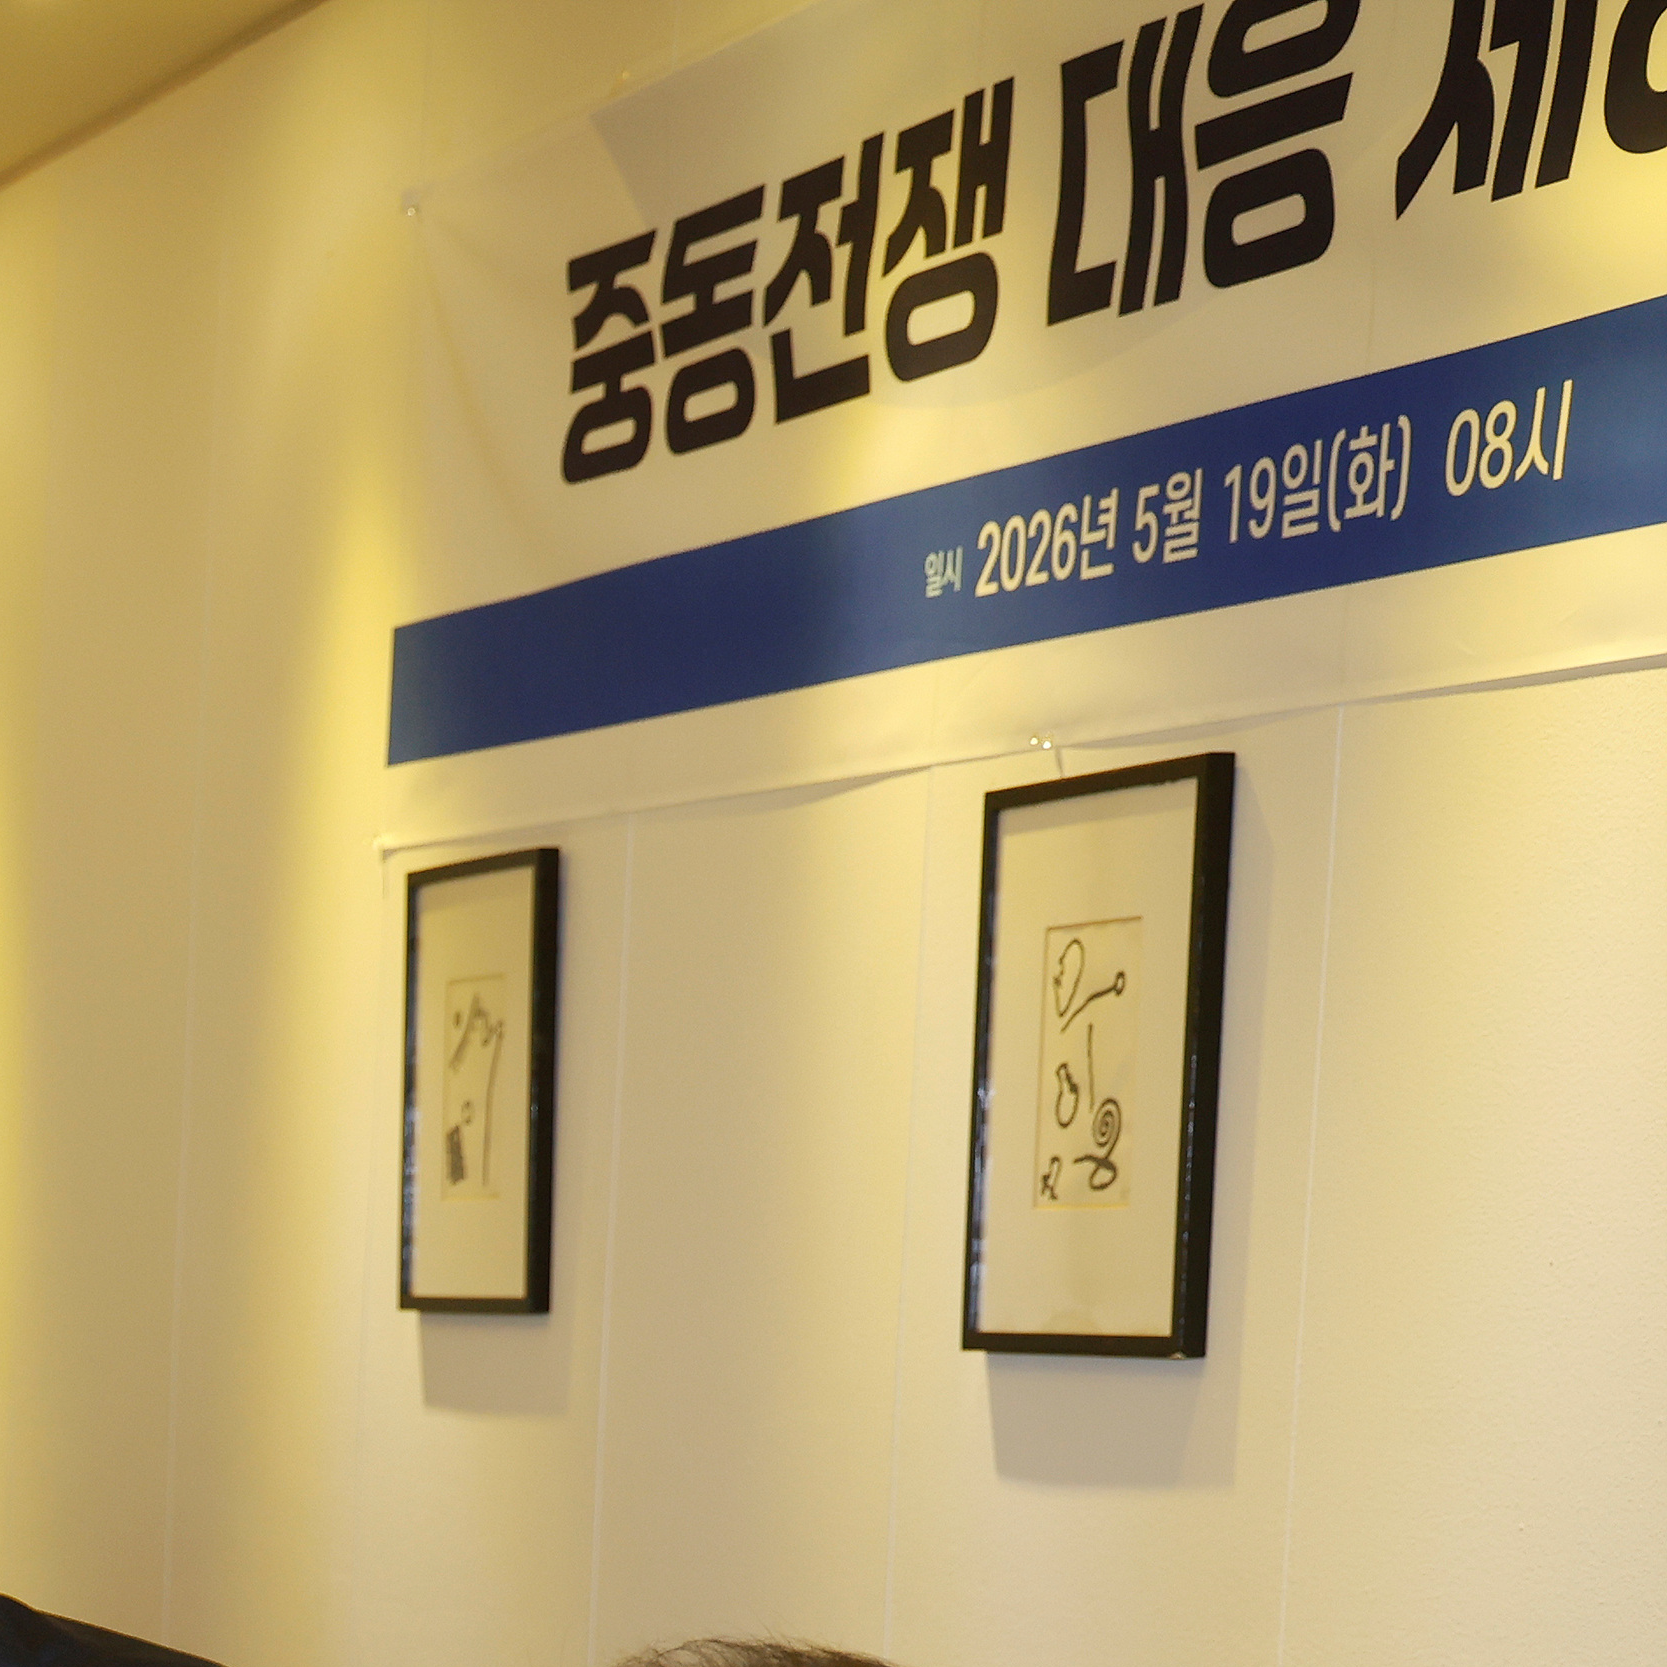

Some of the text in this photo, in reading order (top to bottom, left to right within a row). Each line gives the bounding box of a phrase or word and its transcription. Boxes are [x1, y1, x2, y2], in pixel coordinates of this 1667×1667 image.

[560, 75, 1016, 486] 중동전쟁
[1048, 0, 1361, 327] 대응
[923, 379, 1573, 598] 일시 2026년 5월 19일(화) 08시
